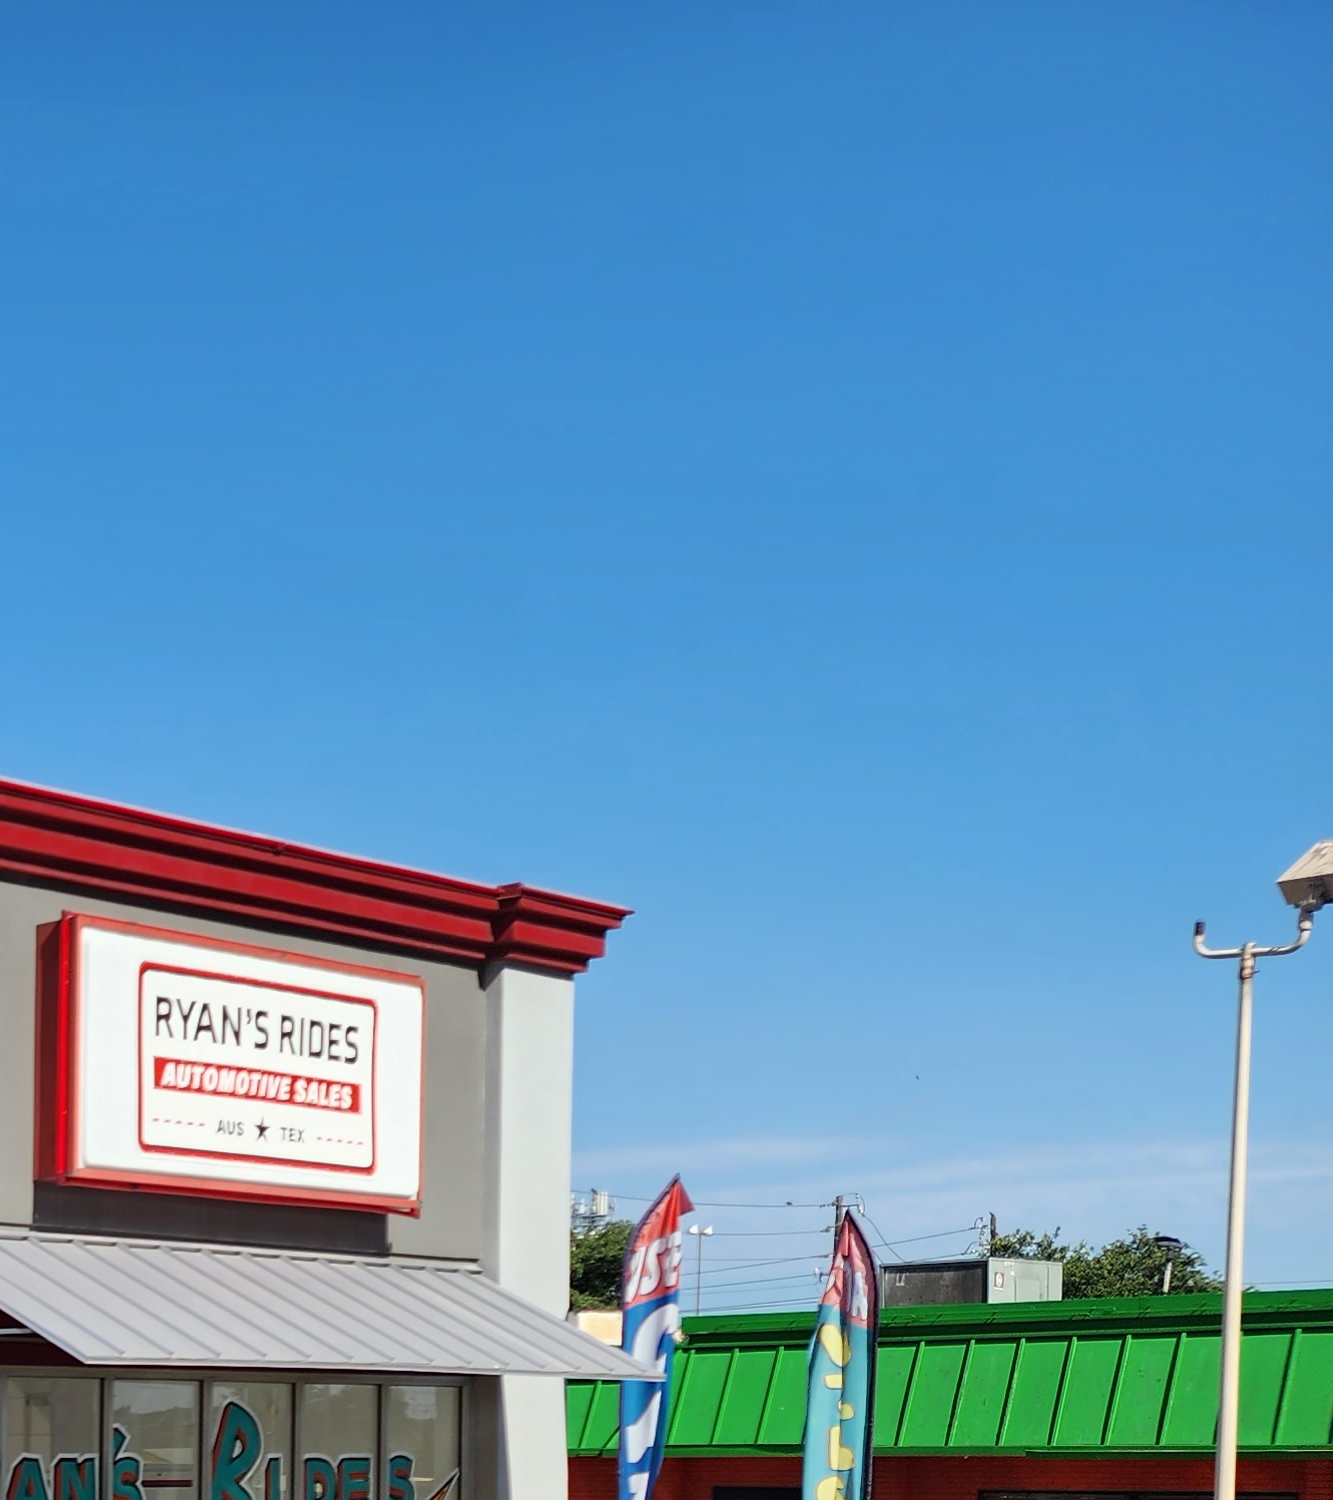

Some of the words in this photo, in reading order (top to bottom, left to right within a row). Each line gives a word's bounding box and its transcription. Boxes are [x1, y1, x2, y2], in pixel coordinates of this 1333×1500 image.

[153, 996, 269, 1050] RYAN'S
[279, 1014, 360, 1065] RIDES
[160, 1061, 291, 1101] AUTOMOTIVE
[293, 1080, 353, 1110] SALES
[215, 1119, 245, 1137] AUS
[279, 1126, 306, 1144] TEX
